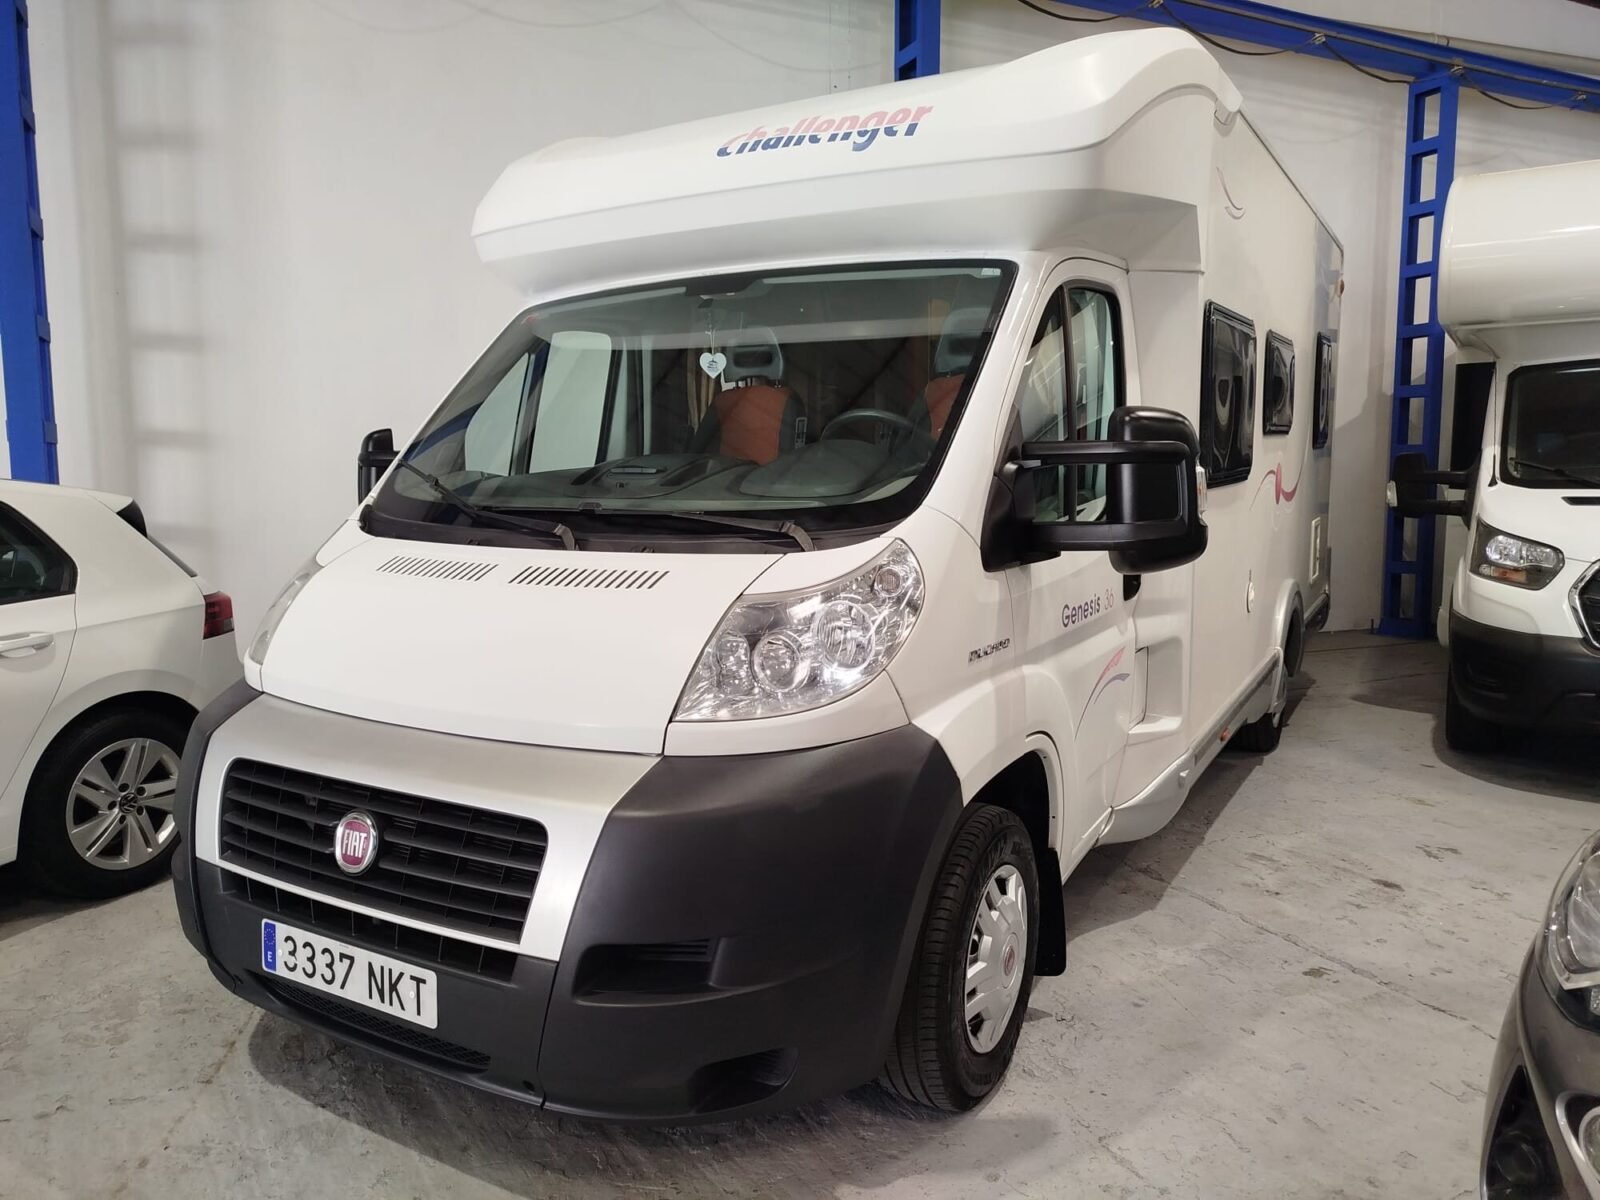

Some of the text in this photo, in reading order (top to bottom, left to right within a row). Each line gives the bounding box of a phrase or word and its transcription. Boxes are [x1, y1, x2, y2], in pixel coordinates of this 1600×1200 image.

[716, 105, 934, 157] Challenger
[1061, 588, 1115, 628] Genesis 36
[342, 829, 368, 858] FIAT
[267, 951, 273, 962] E
[283, 935, 427, 1017] 3337 NKT
